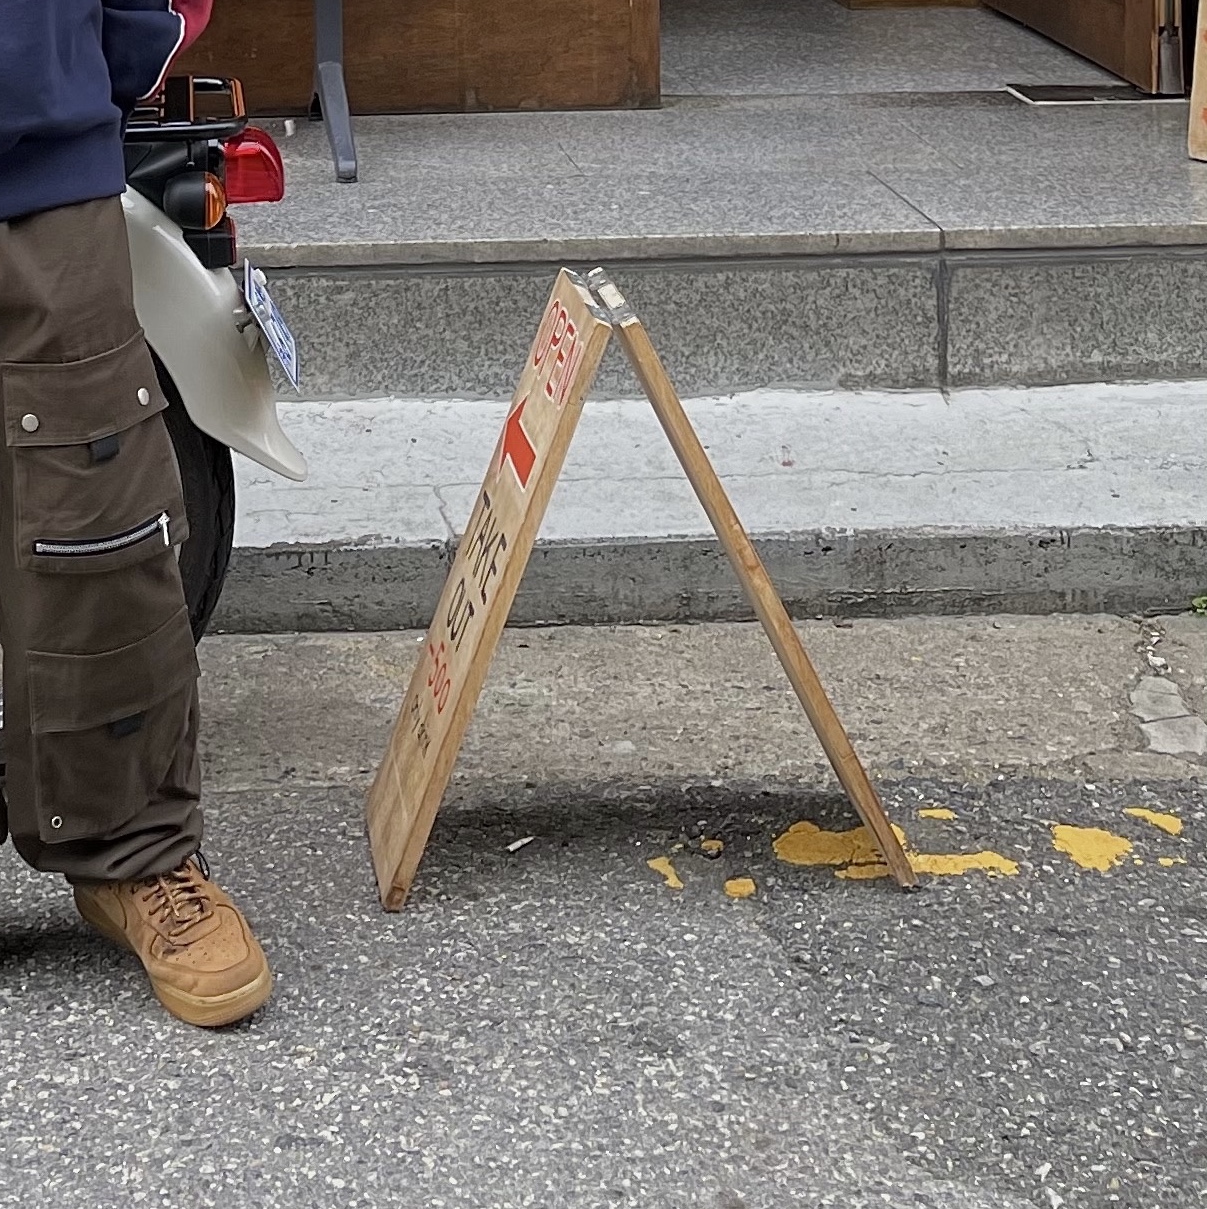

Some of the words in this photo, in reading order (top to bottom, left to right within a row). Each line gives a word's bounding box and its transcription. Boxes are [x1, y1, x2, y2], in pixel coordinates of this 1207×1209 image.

[534, 300, 582, 408] OPEN
[465, 489, 508, 606] TAKE
[446, 578, 475, 653] OUT
